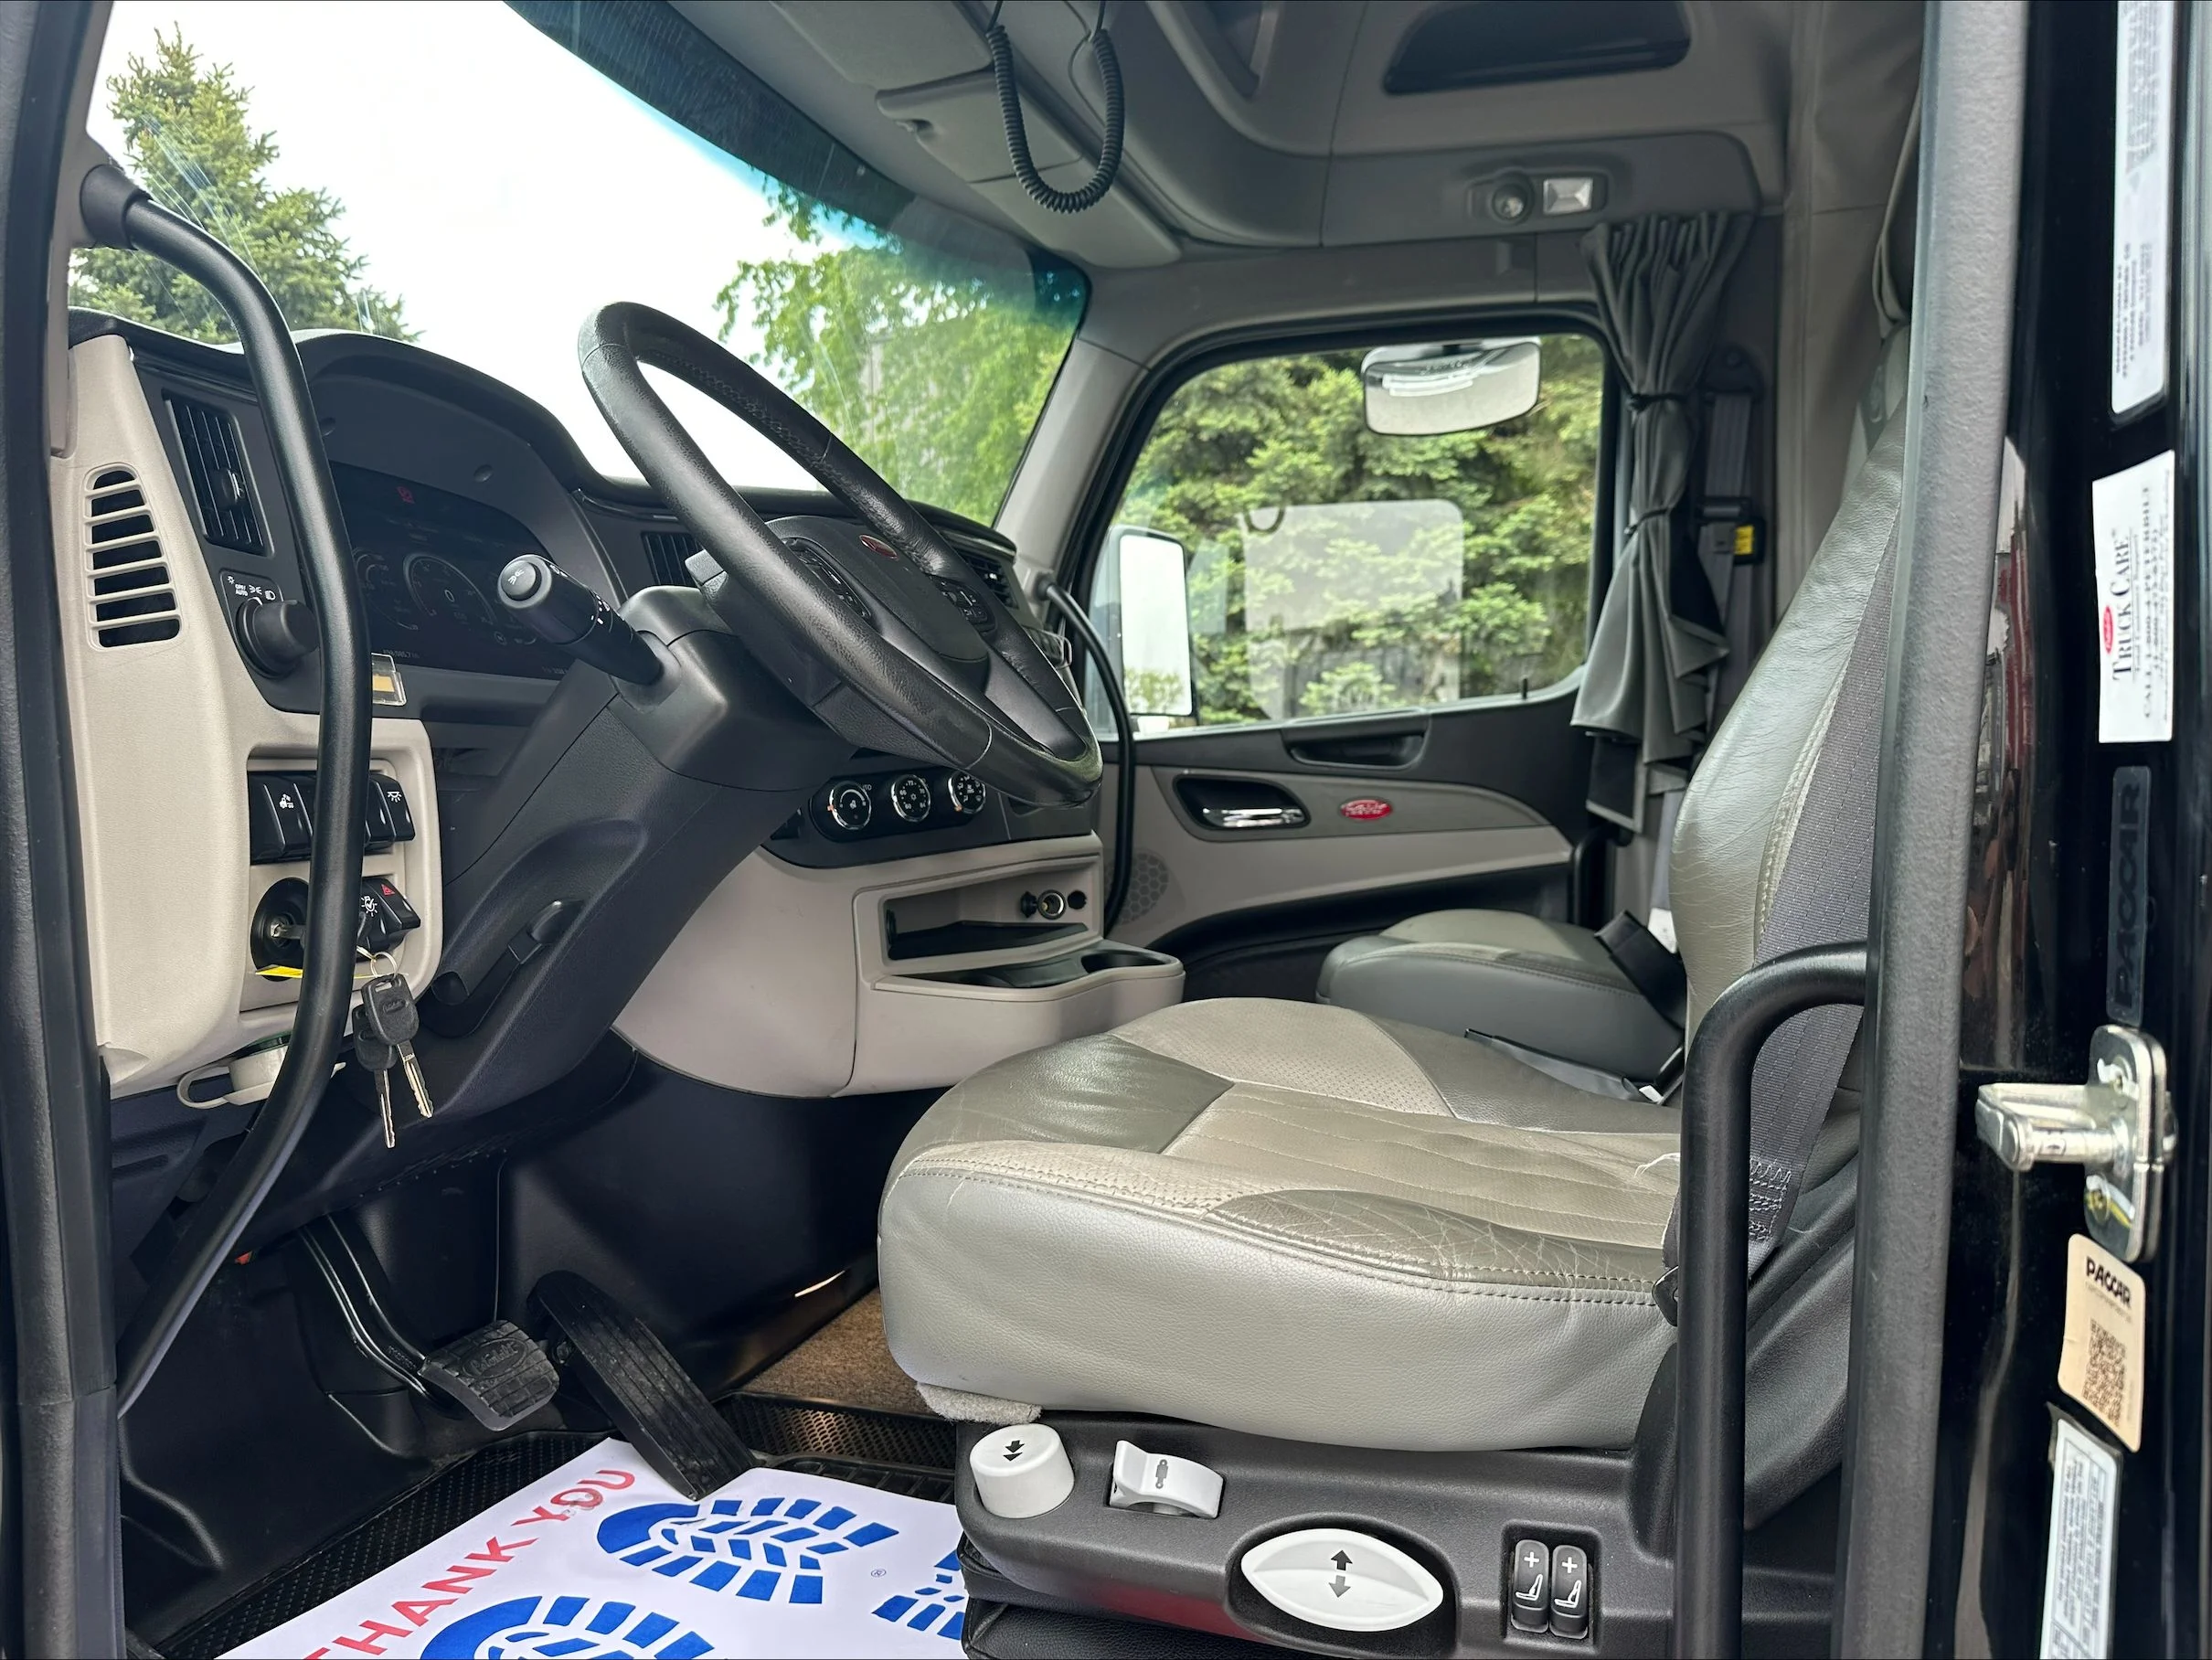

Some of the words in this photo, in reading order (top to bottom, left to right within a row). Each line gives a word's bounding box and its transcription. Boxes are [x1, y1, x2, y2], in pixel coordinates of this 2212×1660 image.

[2111, 602, 2132, 681] TRUCK
[2114, 782, 2140, 1009] PACCAR
[2086, 1256, 2132, 1308] PACCAR
[510, 1469, 636, 1527] YOU
